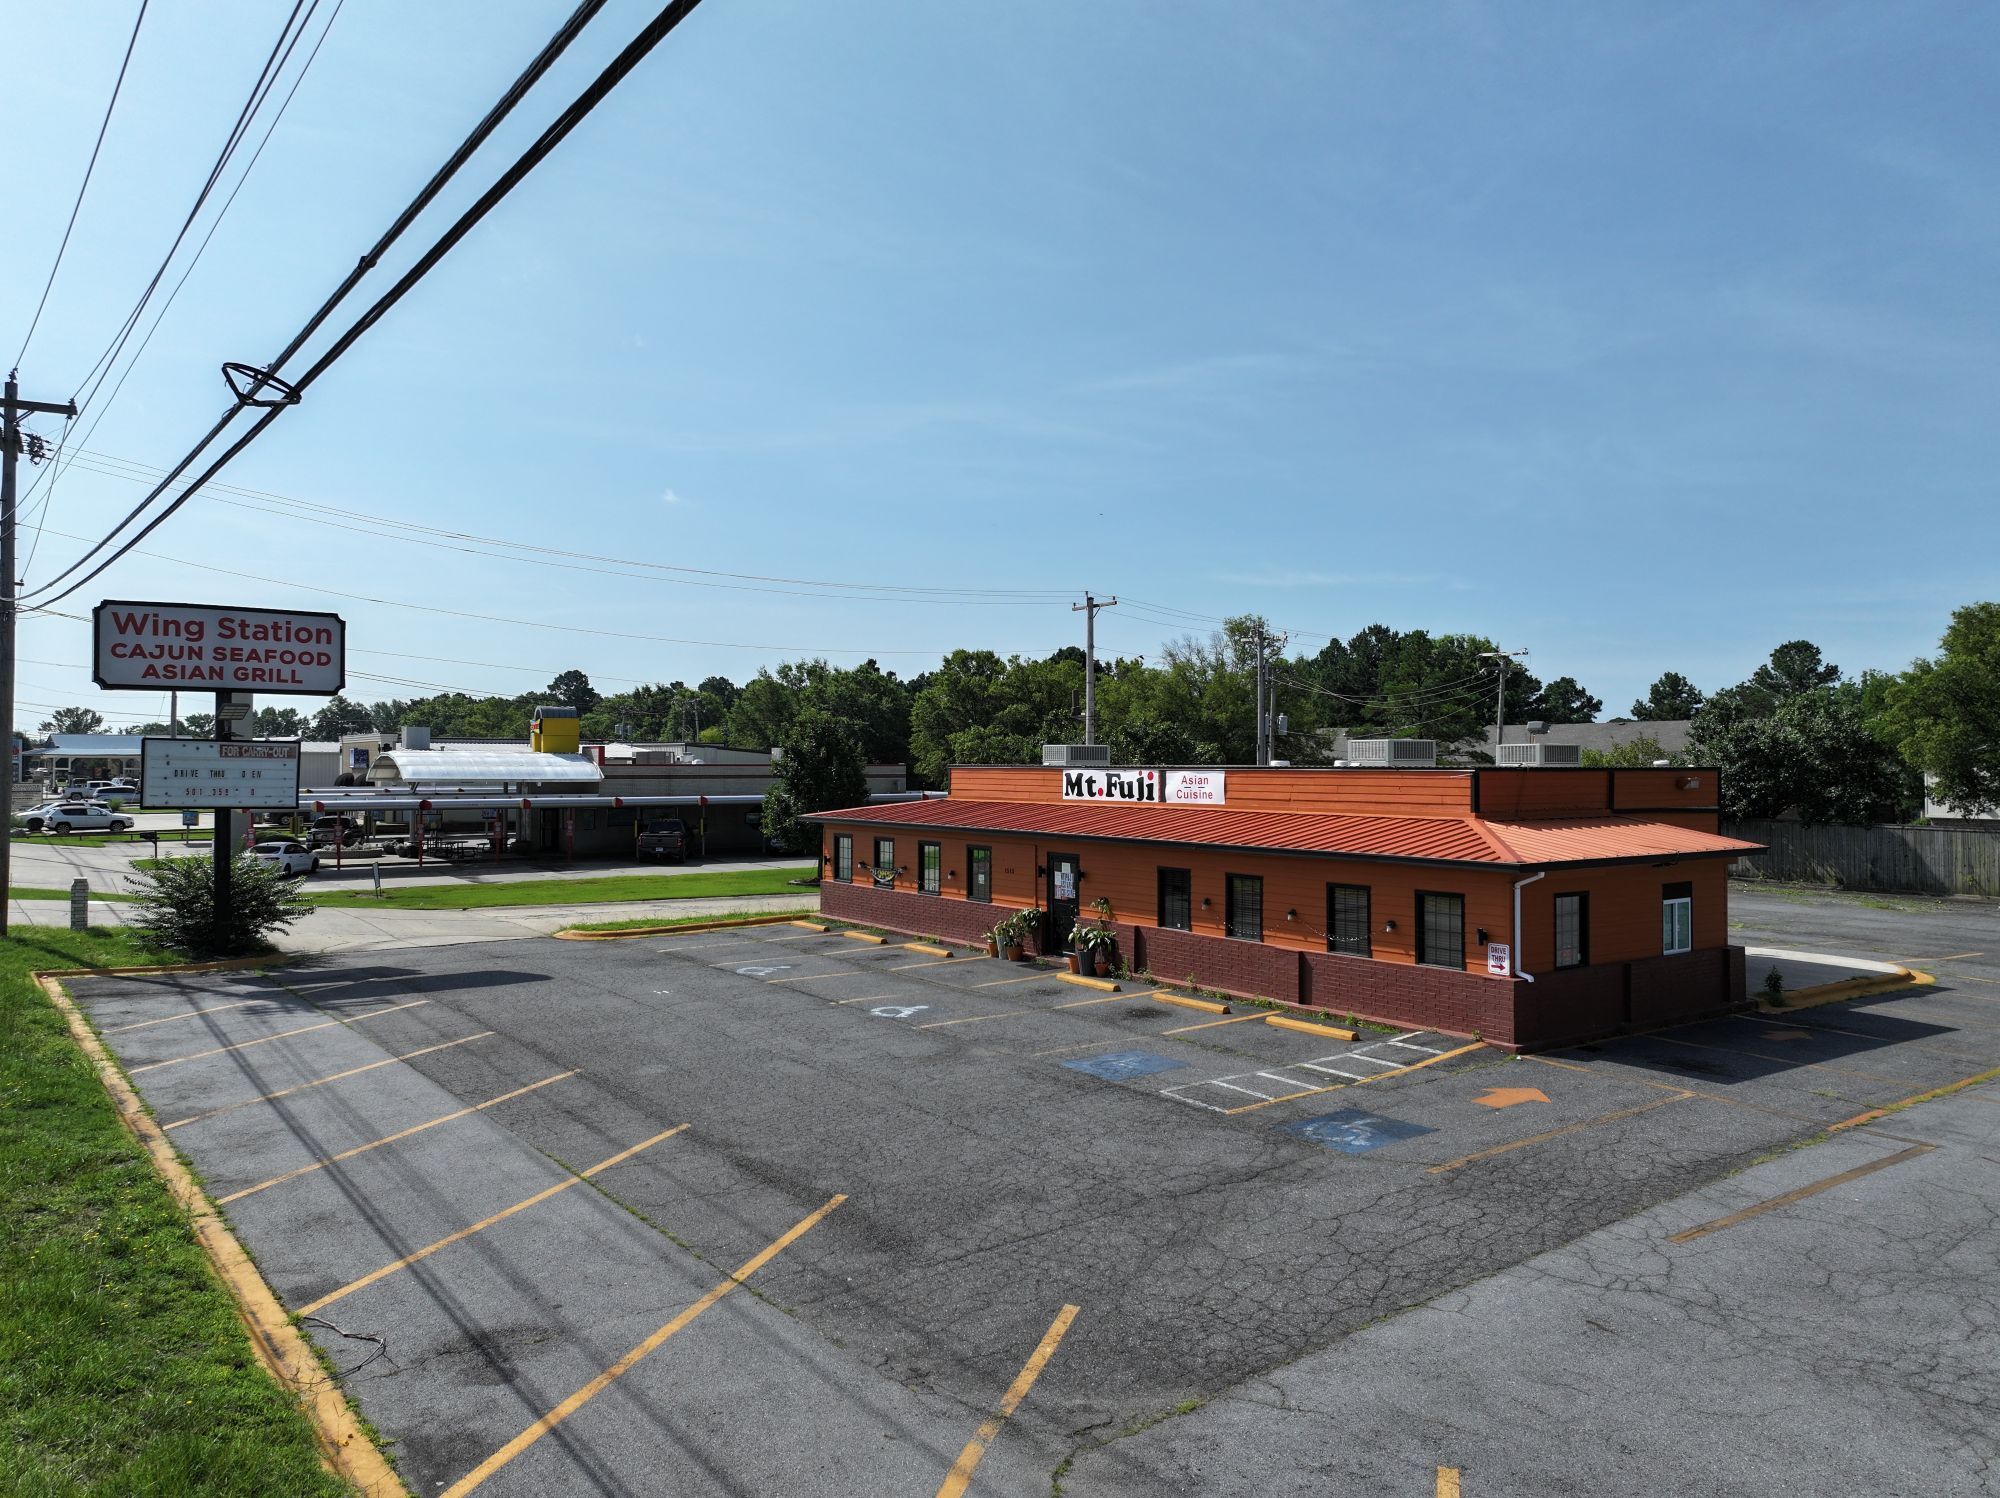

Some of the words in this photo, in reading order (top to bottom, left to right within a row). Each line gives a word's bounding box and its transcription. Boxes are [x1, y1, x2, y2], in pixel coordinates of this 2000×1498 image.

[112, 611, 204, 642] Wing
[217, 617, 333, 645] Station
[110, 643, 203, 661] CAJUN
[212, 647, 332, 667] SEAFOOD
[141, 664, 224, 681] ASIAN
[233, 667, 304, 684] GRILL
[222, 746, 239, 757] FOR
[242, 746, 290, 758] CARRY-OUT
[174, 769, 199, 778] DRIVE
[1181, 775, 1209, 785] Asian
[1176, 789, 1213, 800] Cuisine
[1491, 946, 1507, 955] DRIVE
